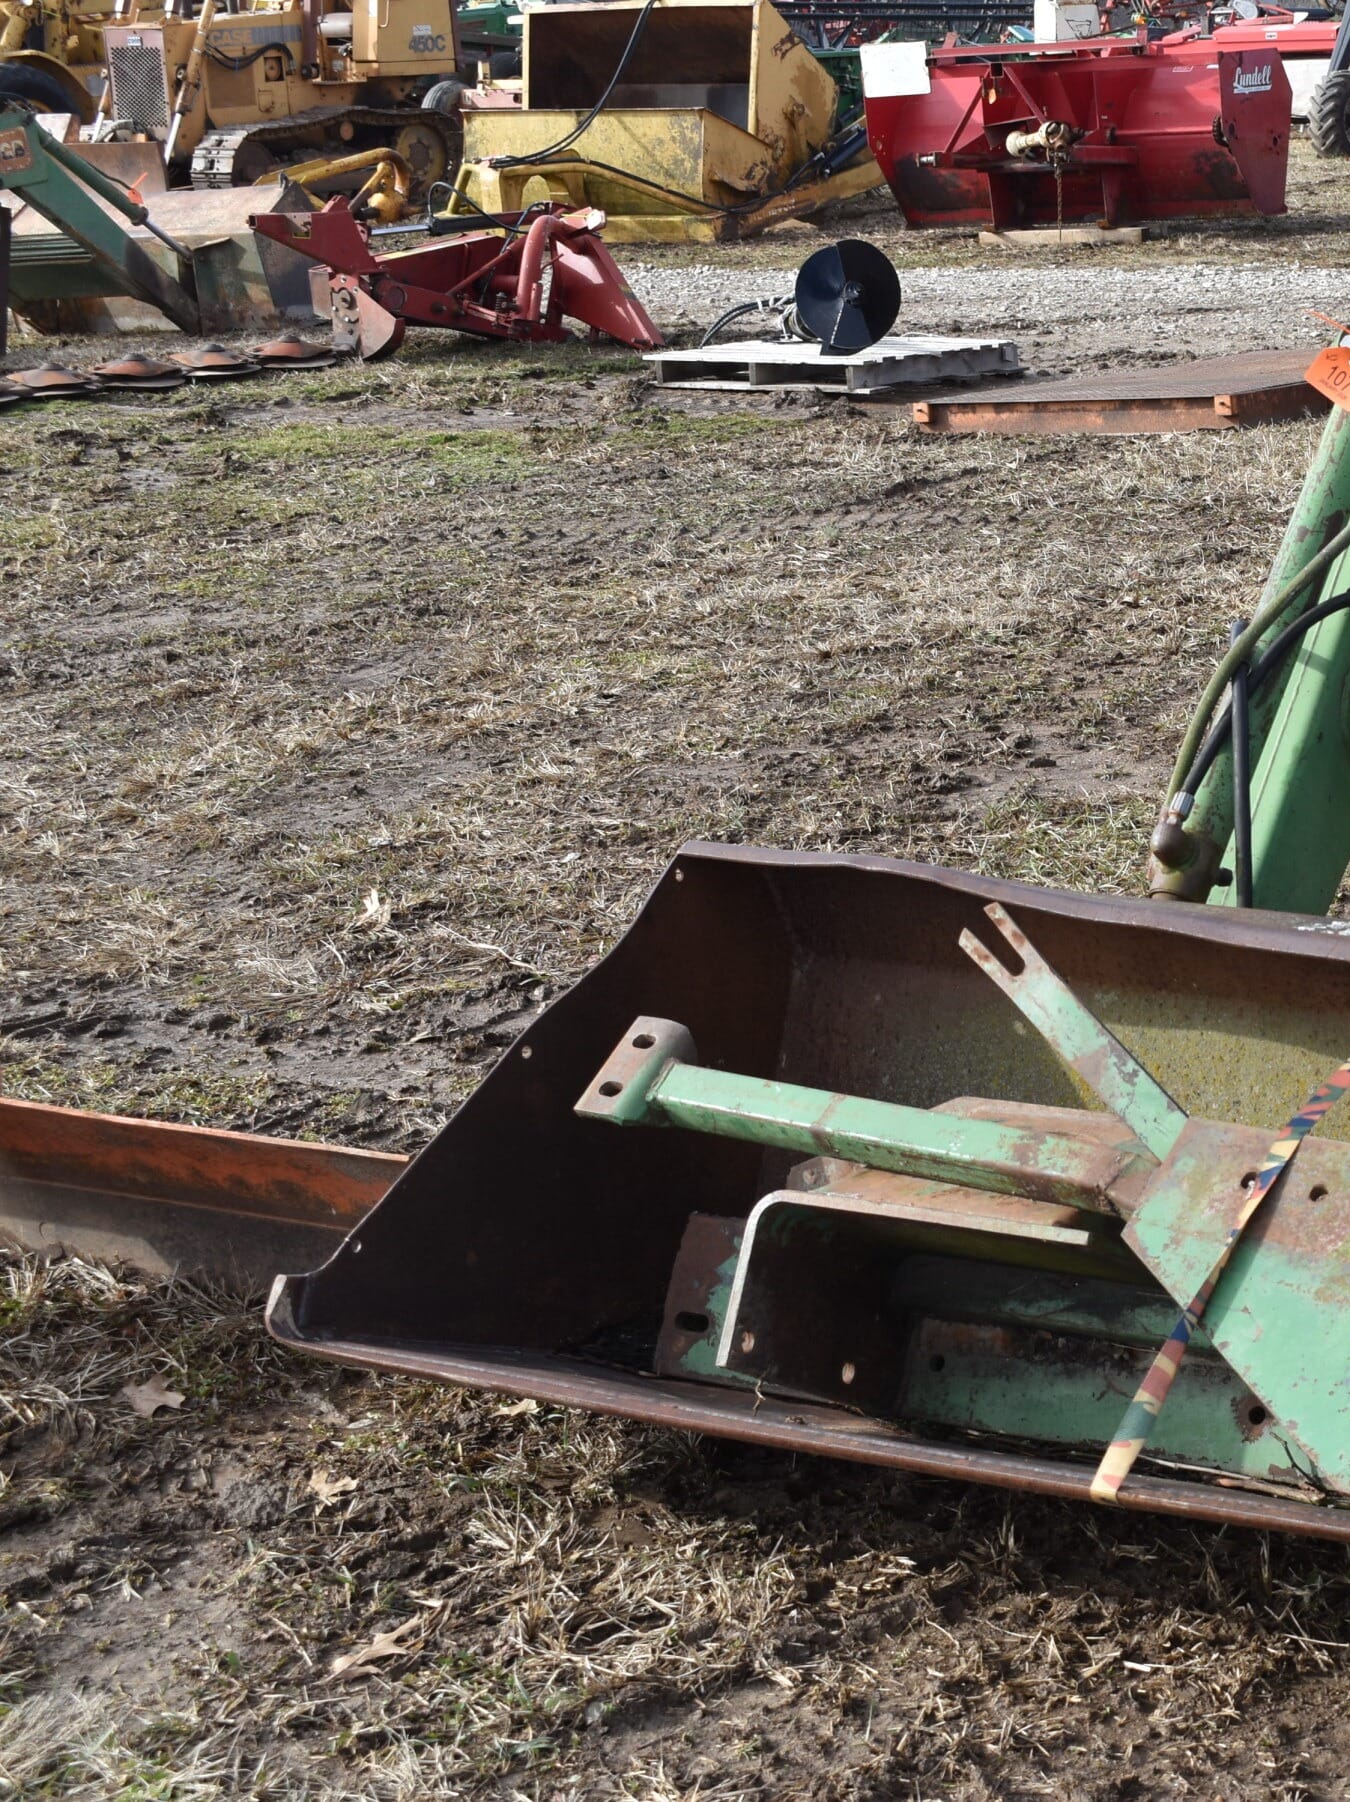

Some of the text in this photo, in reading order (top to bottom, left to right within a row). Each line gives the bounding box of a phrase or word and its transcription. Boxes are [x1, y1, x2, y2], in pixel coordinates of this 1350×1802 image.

[208, 29, 253, 43] CASE
[408, 34, 446, 53] 450C
[1233, 65, 1272, 89] Lundell
